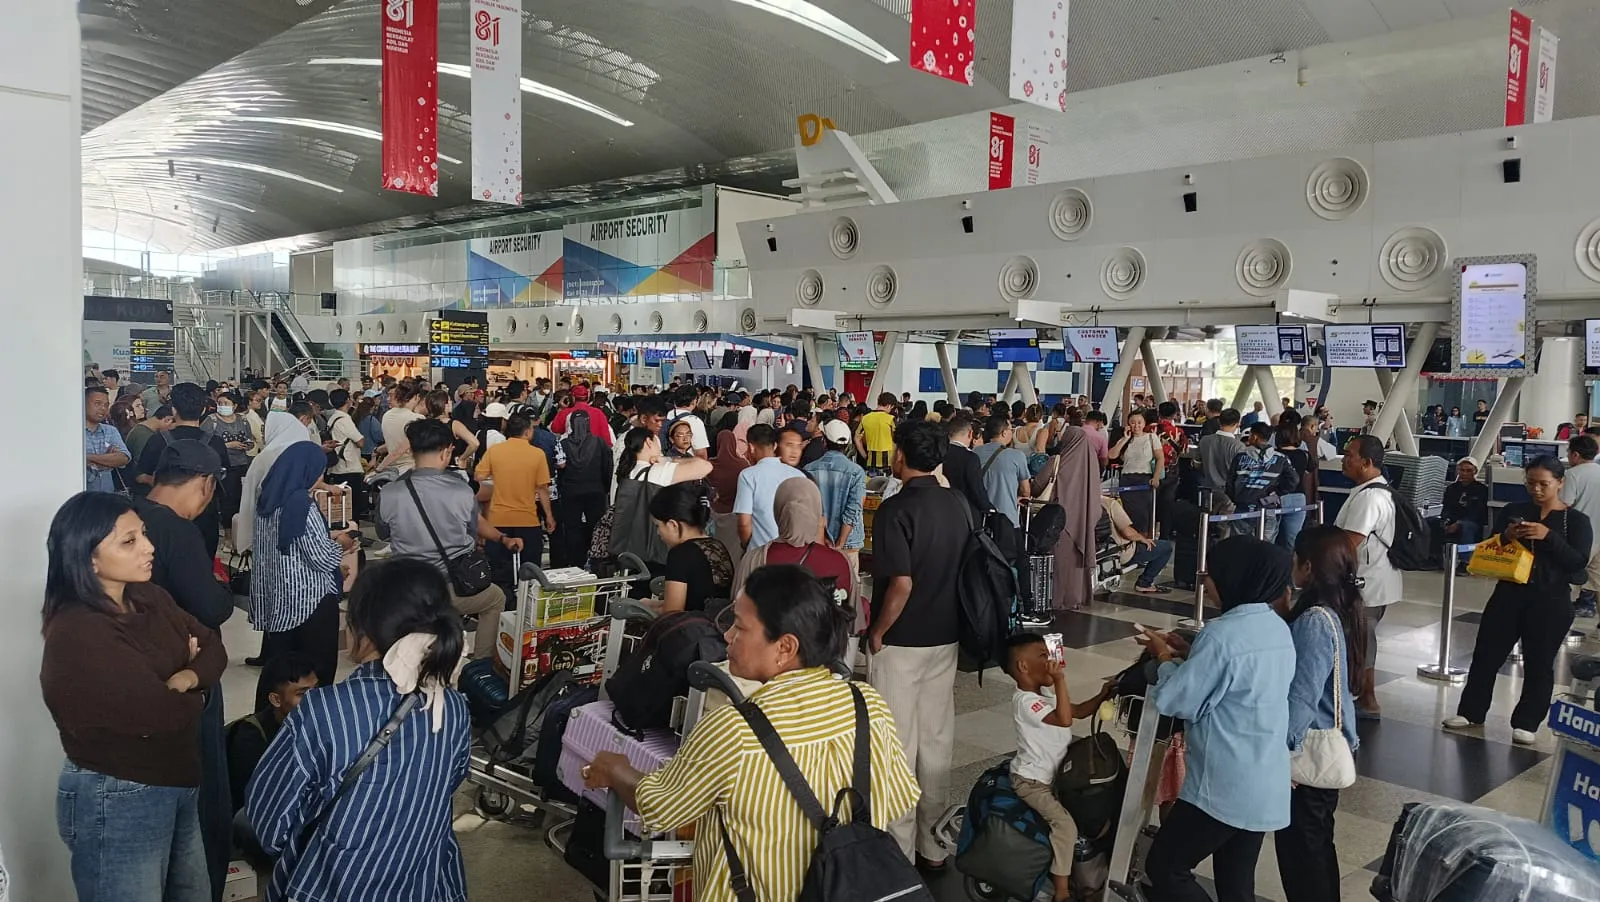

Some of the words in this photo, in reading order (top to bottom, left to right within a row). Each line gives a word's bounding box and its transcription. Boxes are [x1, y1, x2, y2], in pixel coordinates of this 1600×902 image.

[475, 10, 501, 47] 81
[990, 135, 1005, 162] 81
[590, 219, 625, 243] AIRPORT
[626, 213, 669, 237] SECURITY
[489, 238, 513, 256] AIRPORT
[513, 234, 542, 252] SECURITY
